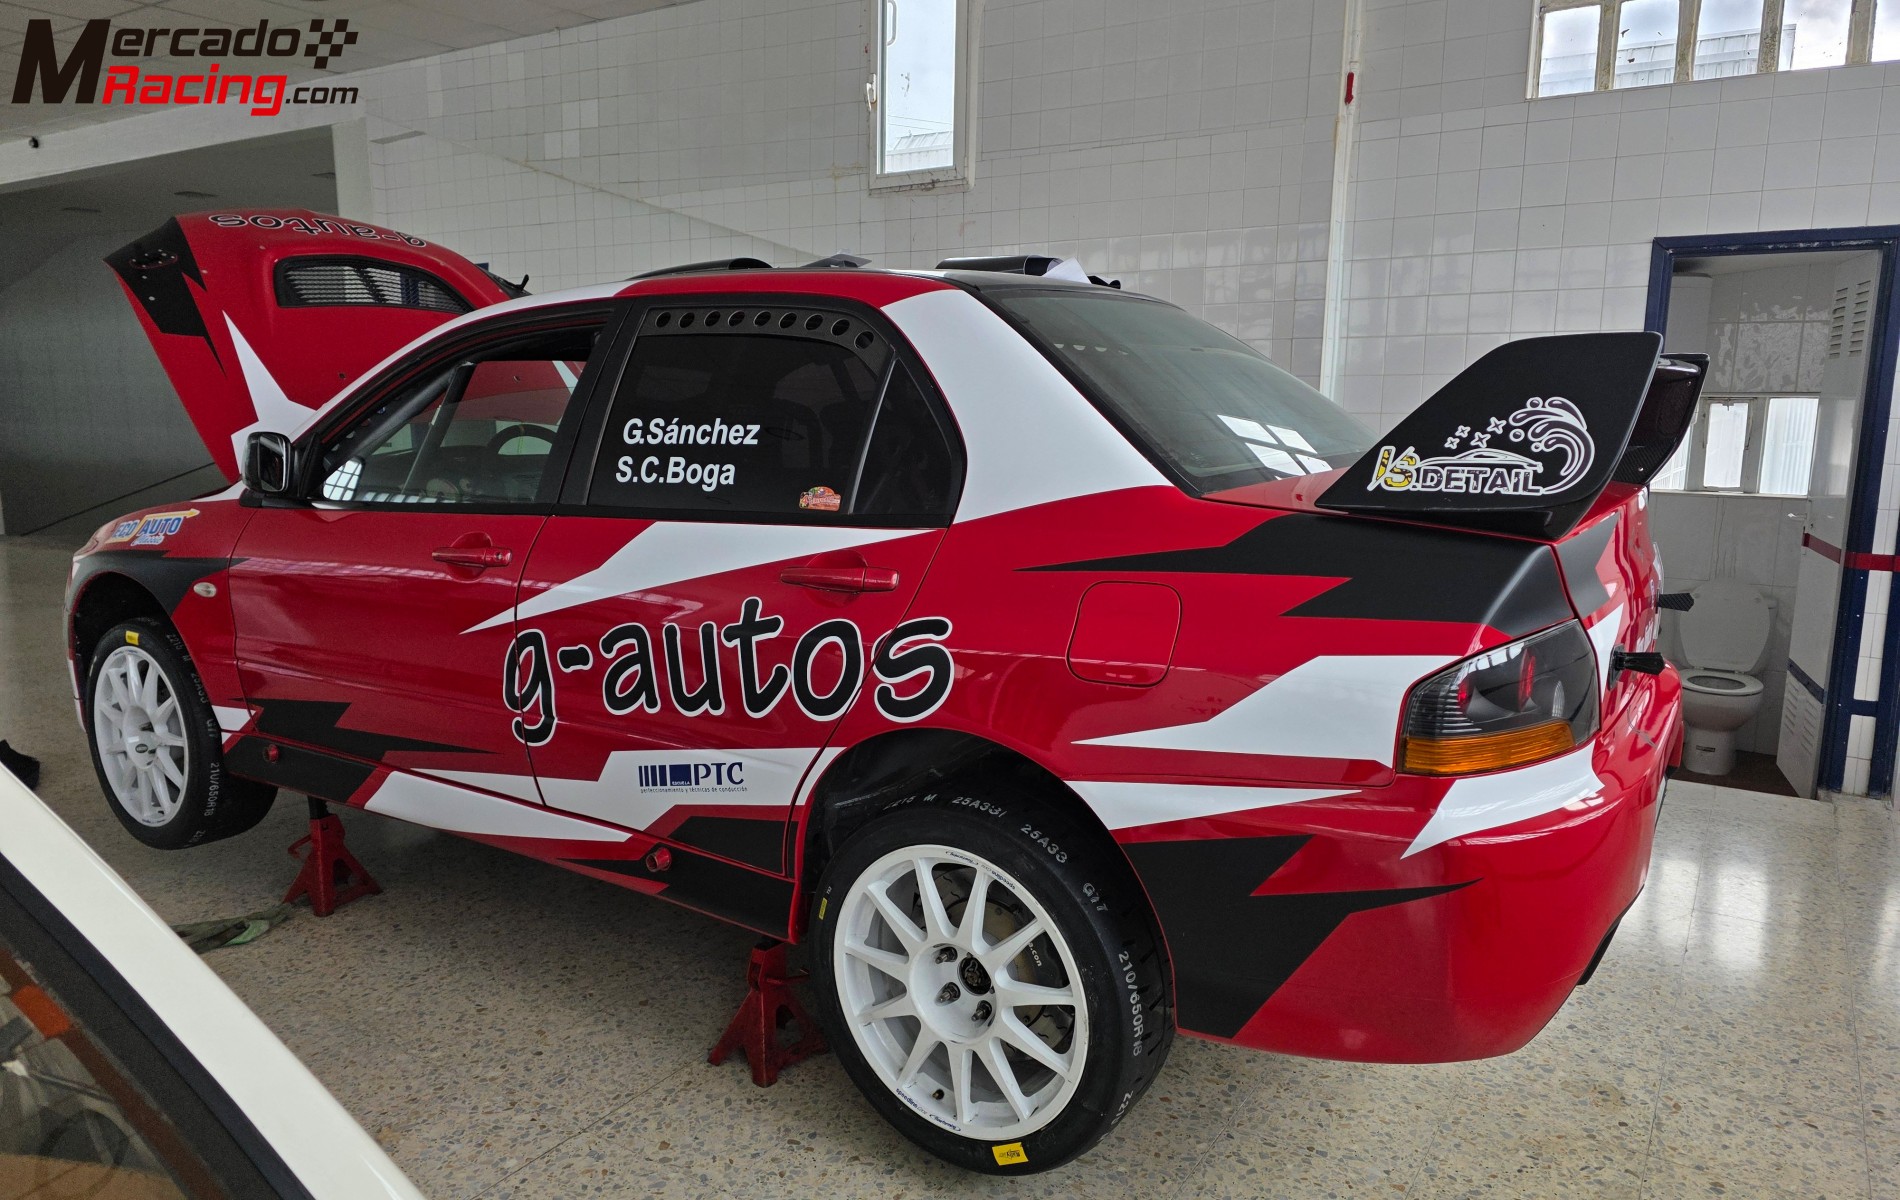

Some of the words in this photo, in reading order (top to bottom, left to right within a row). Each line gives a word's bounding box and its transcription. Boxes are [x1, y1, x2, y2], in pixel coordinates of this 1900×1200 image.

[208, 213, 427, 248] g-autos
[623, 417, 761, 445] G.Sánchez
[615, 455, 736, 492] S.C.Boga
[137, 516, 183, 535] AUTO
[502, 597, 956, 747] g-autos
[693, 761, 745, 786] PTC
[1020, 823, 1068, 864] 25A33
